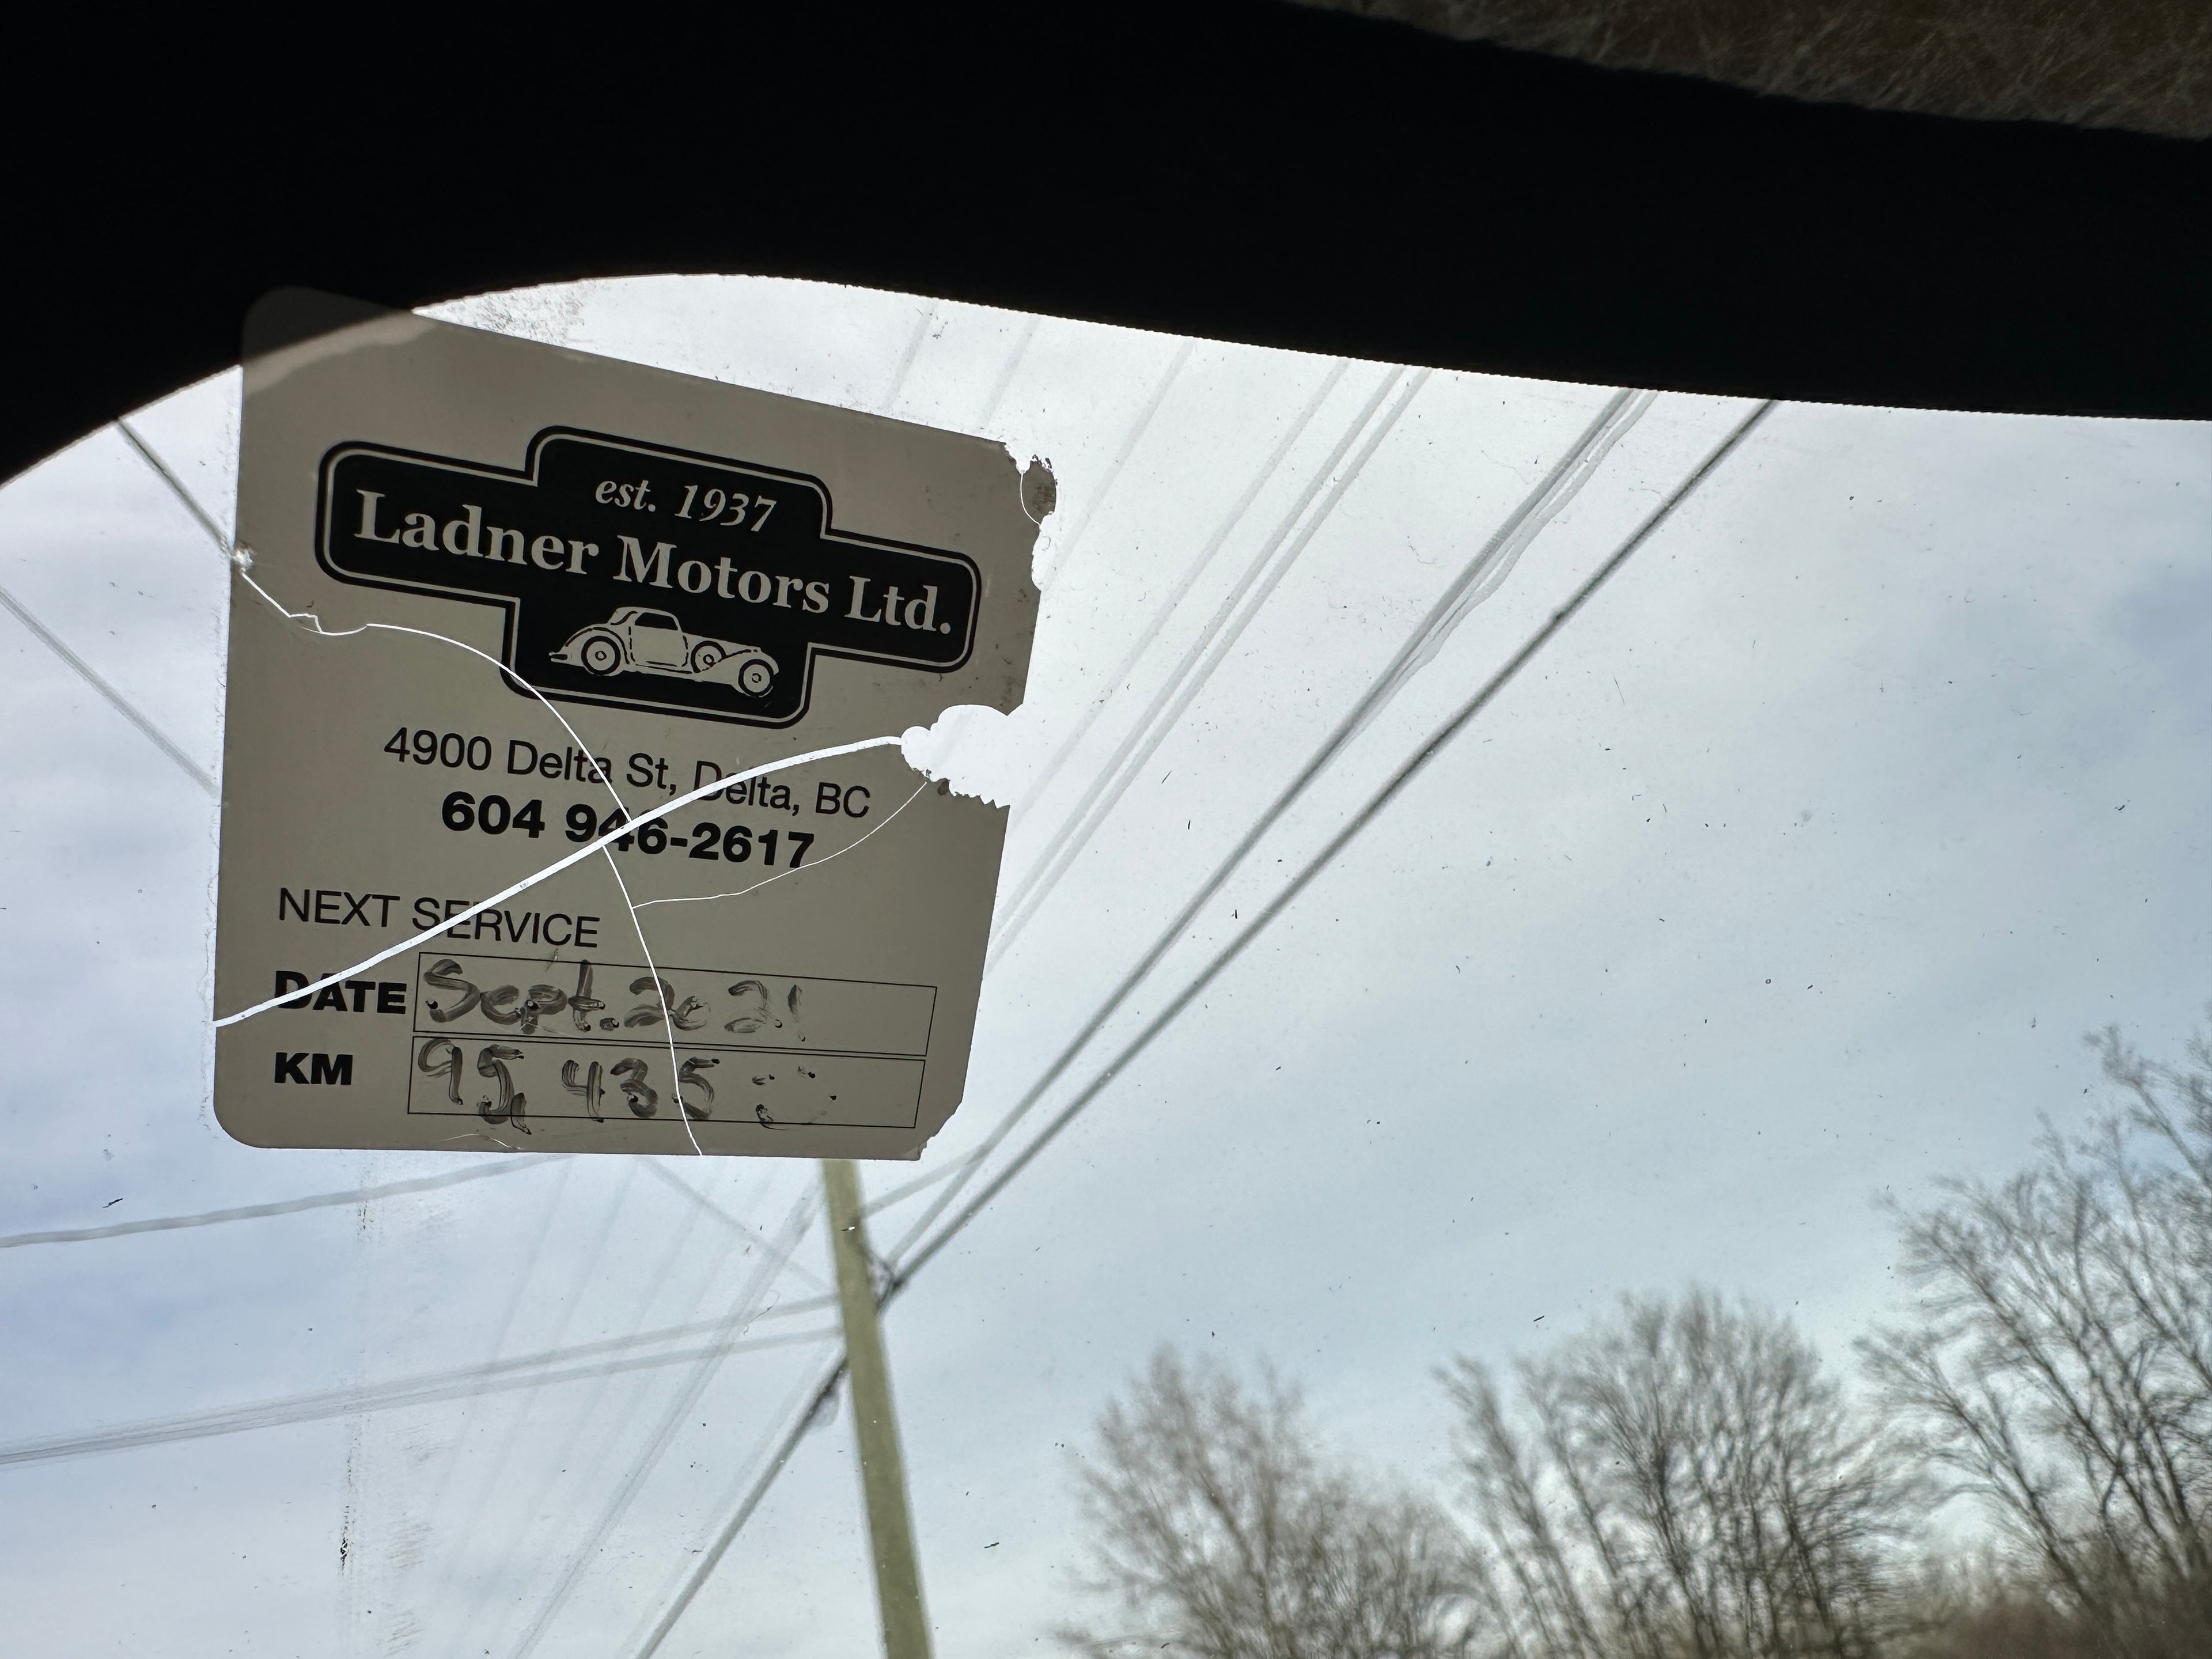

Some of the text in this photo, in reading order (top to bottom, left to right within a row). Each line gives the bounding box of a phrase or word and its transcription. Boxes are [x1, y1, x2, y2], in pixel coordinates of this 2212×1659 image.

[595, 479, 777, 532] est. 1937
[354, 489, 952, 634] Ladner Motors Ltd.
[384, 727, 870, 818] 4900 Delta St, Delta, BC
[441, 791, 815, 869] 604 946-2617
[279, 887, 600, 948] NEXT SERVICE
[273, 970, 407, 1015] DATE
[274, 1052, 353, 1086] KM
